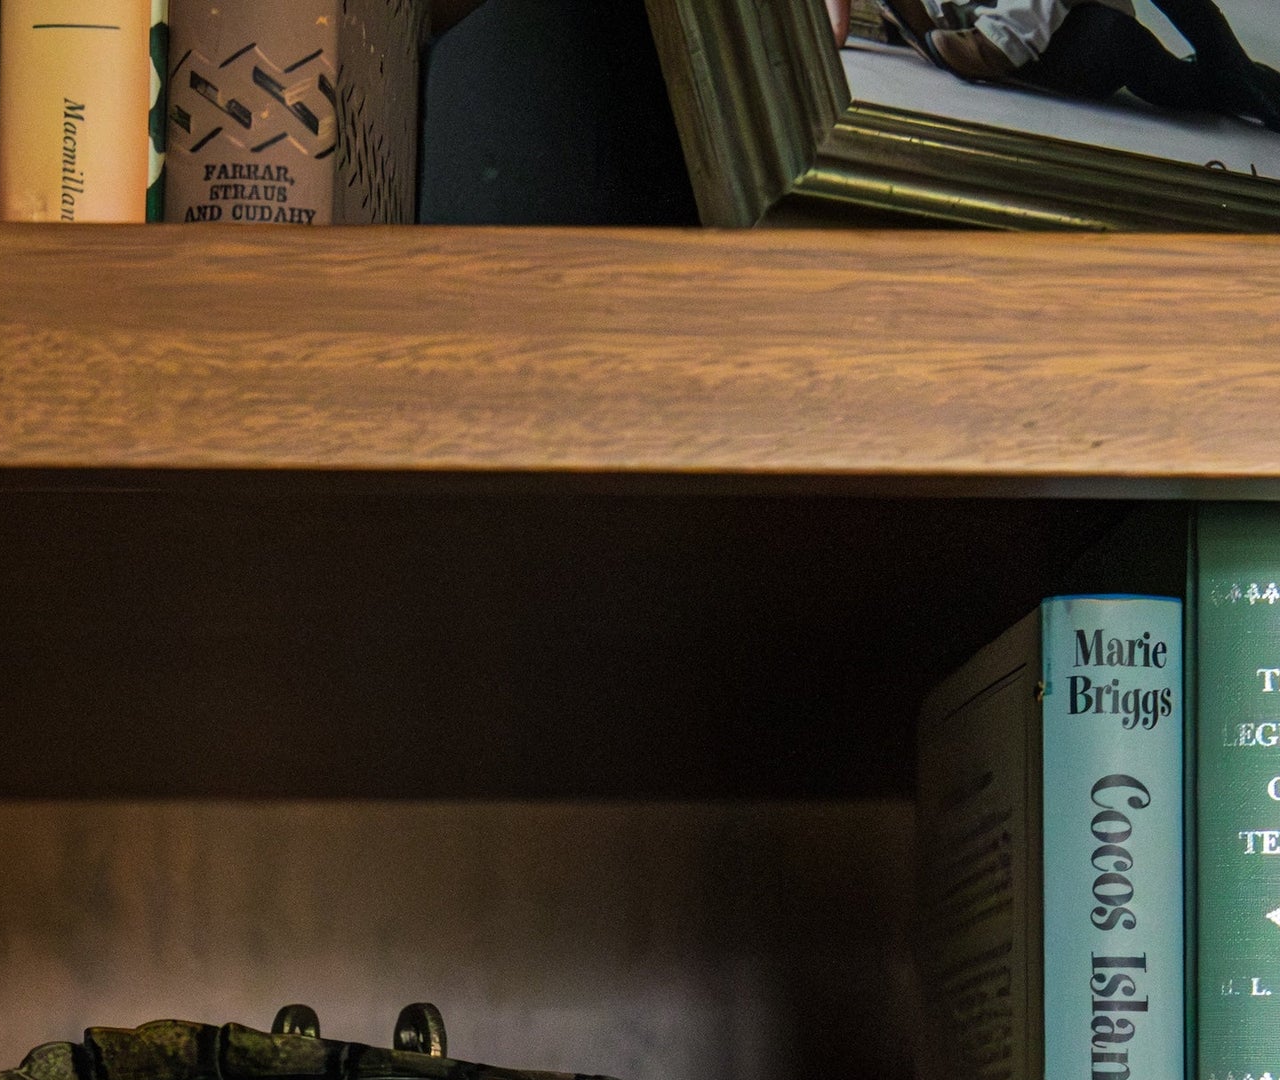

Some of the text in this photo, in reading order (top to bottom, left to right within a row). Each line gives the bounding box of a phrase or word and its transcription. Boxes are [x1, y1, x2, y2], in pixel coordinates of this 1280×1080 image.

[61, 98, 86, 221] Macmillan
[204, 163, 295, 186] FARRAR,
[209, 184, 288, 203] STRAUS
[184, 204, 317, 225] AND CUDAHY
[1072, 629, 1167, 669] Marie
[1066, 675, 1172, 730] Briggs
[1089, 772, 1152, 932] Cocos
[1250, 977, 1272, 996] L.
